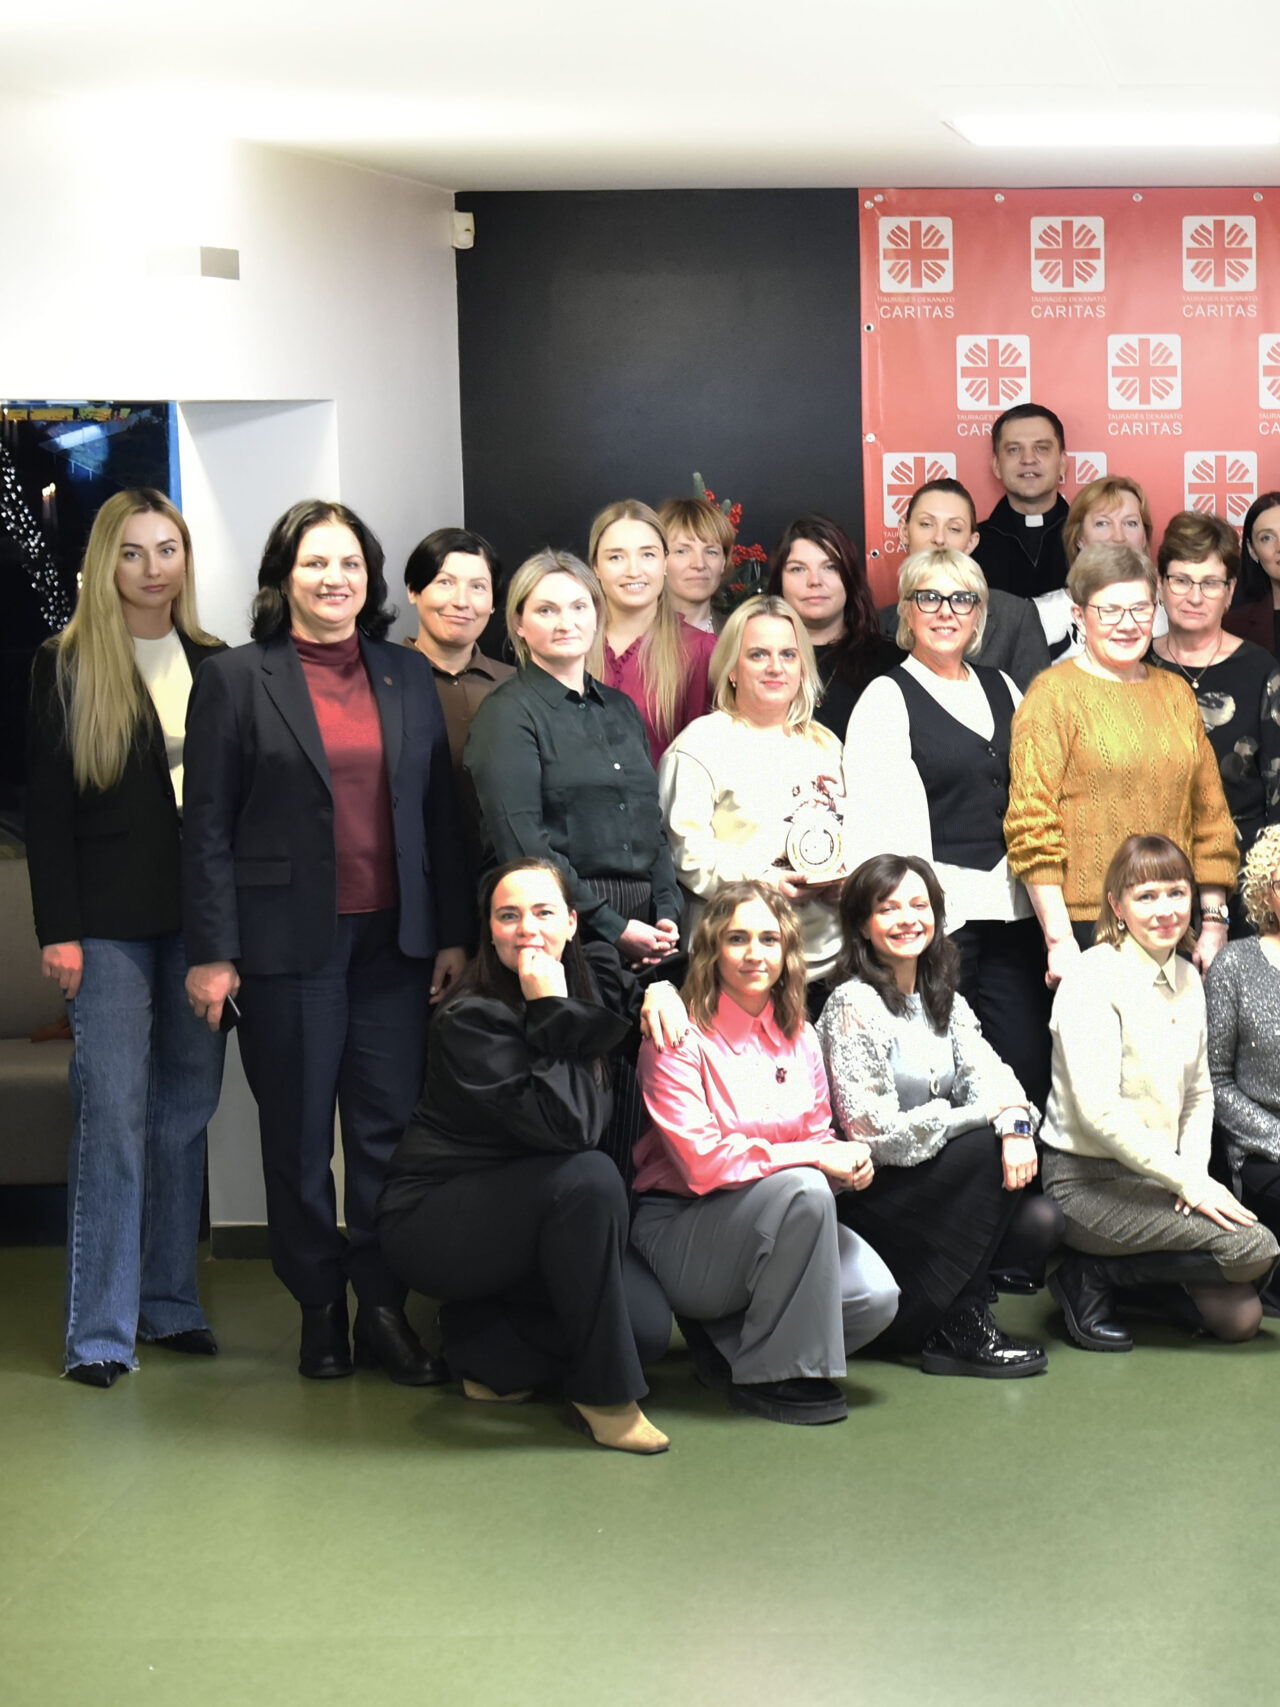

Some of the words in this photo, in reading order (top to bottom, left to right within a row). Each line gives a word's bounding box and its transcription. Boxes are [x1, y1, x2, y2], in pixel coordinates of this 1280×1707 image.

[880, 305, 954, 318] CARITAS
[1031, 305, 1105, 318] CARITAS
[1182, 304, 1257, 317] CARITAS
[1108, 422, 1183, 435] CARITAS
